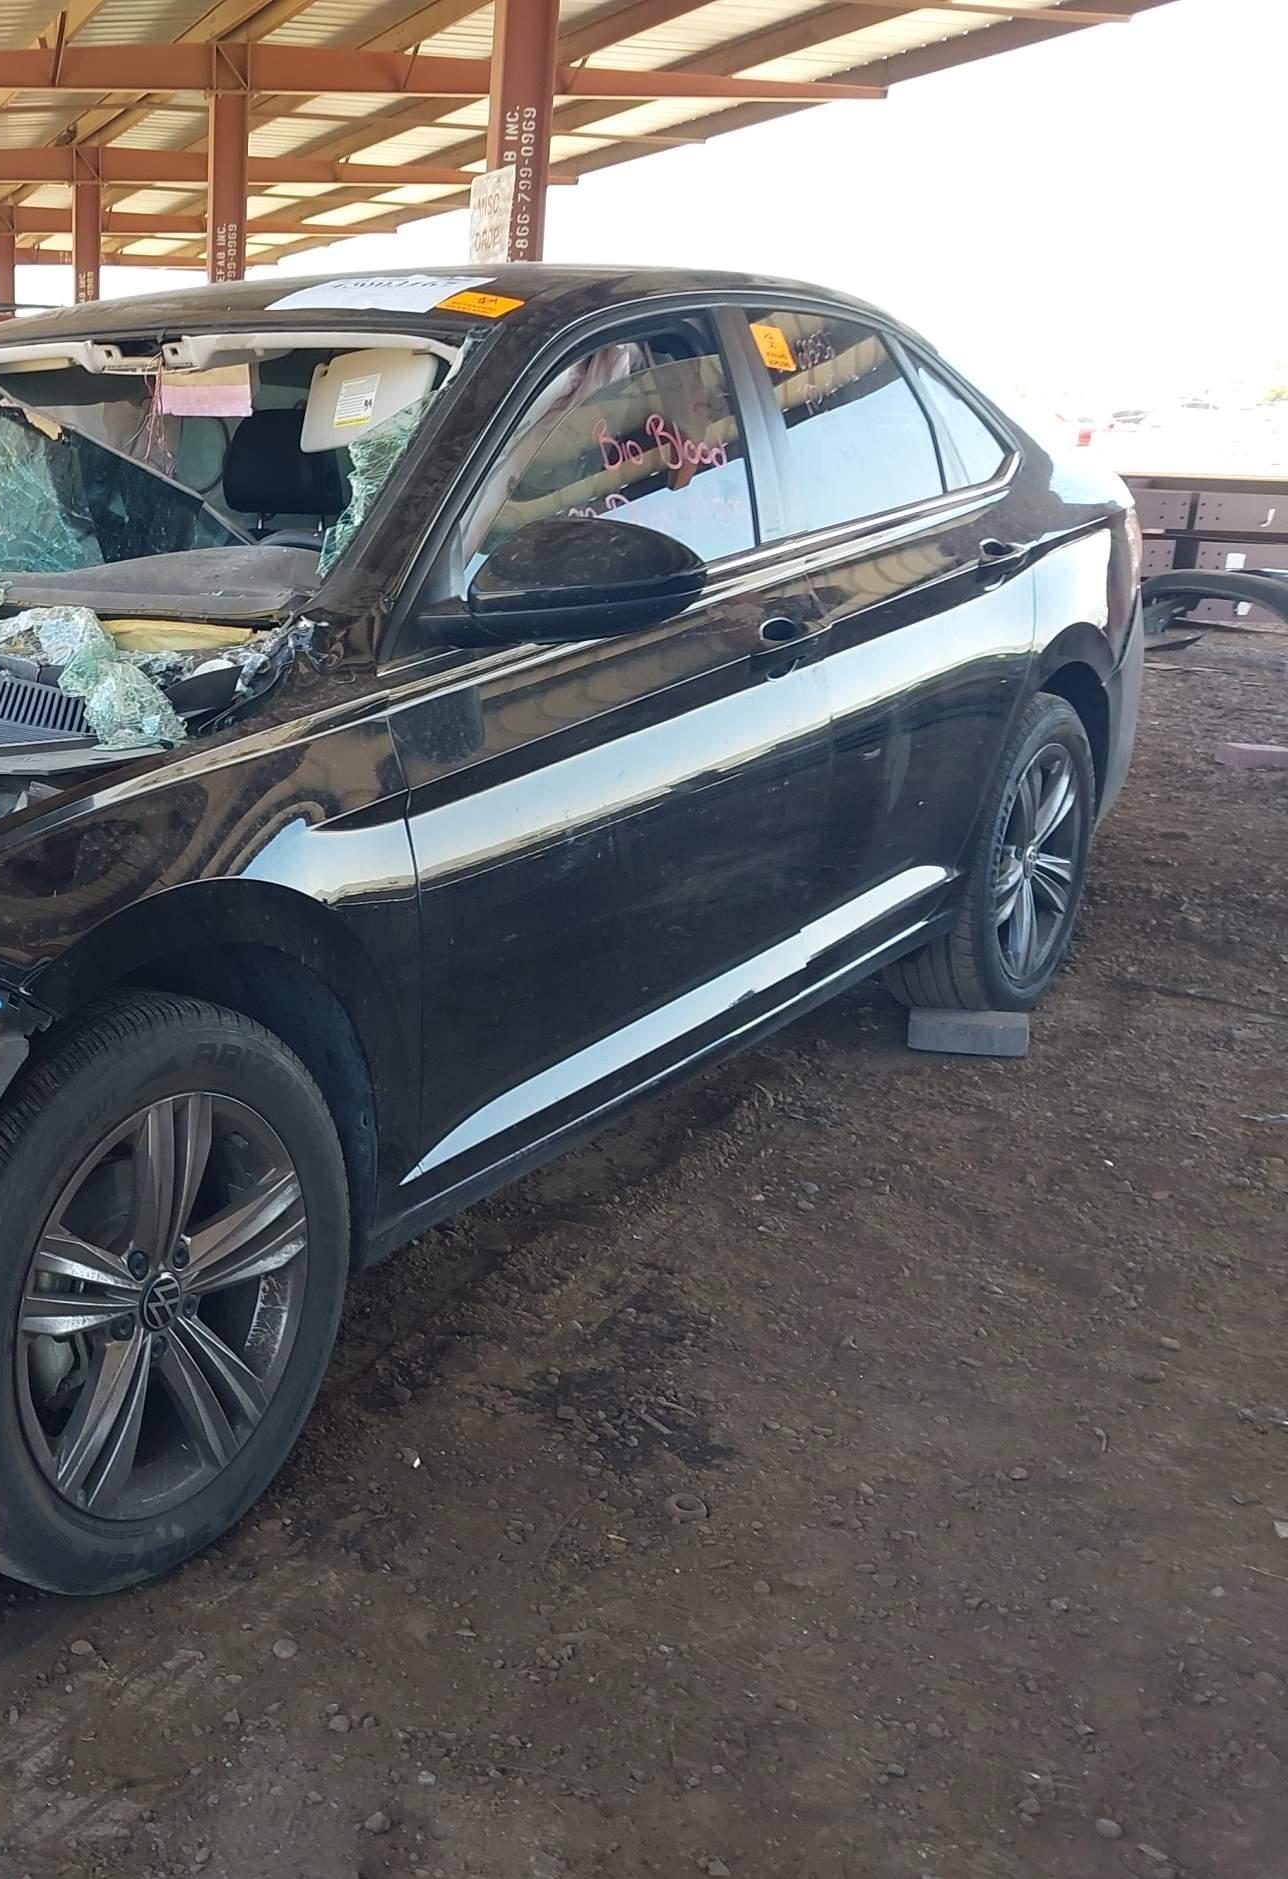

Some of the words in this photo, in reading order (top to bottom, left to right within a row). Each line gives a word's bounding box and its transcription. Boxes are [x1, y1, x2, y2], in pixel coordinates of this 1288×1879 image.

[504, 105, 520, 141] INC.
[215, 251, 226, 281] EFAB
[227, 224, 237, 280] 99-0969
[646, 414, 728, 470] Blood
